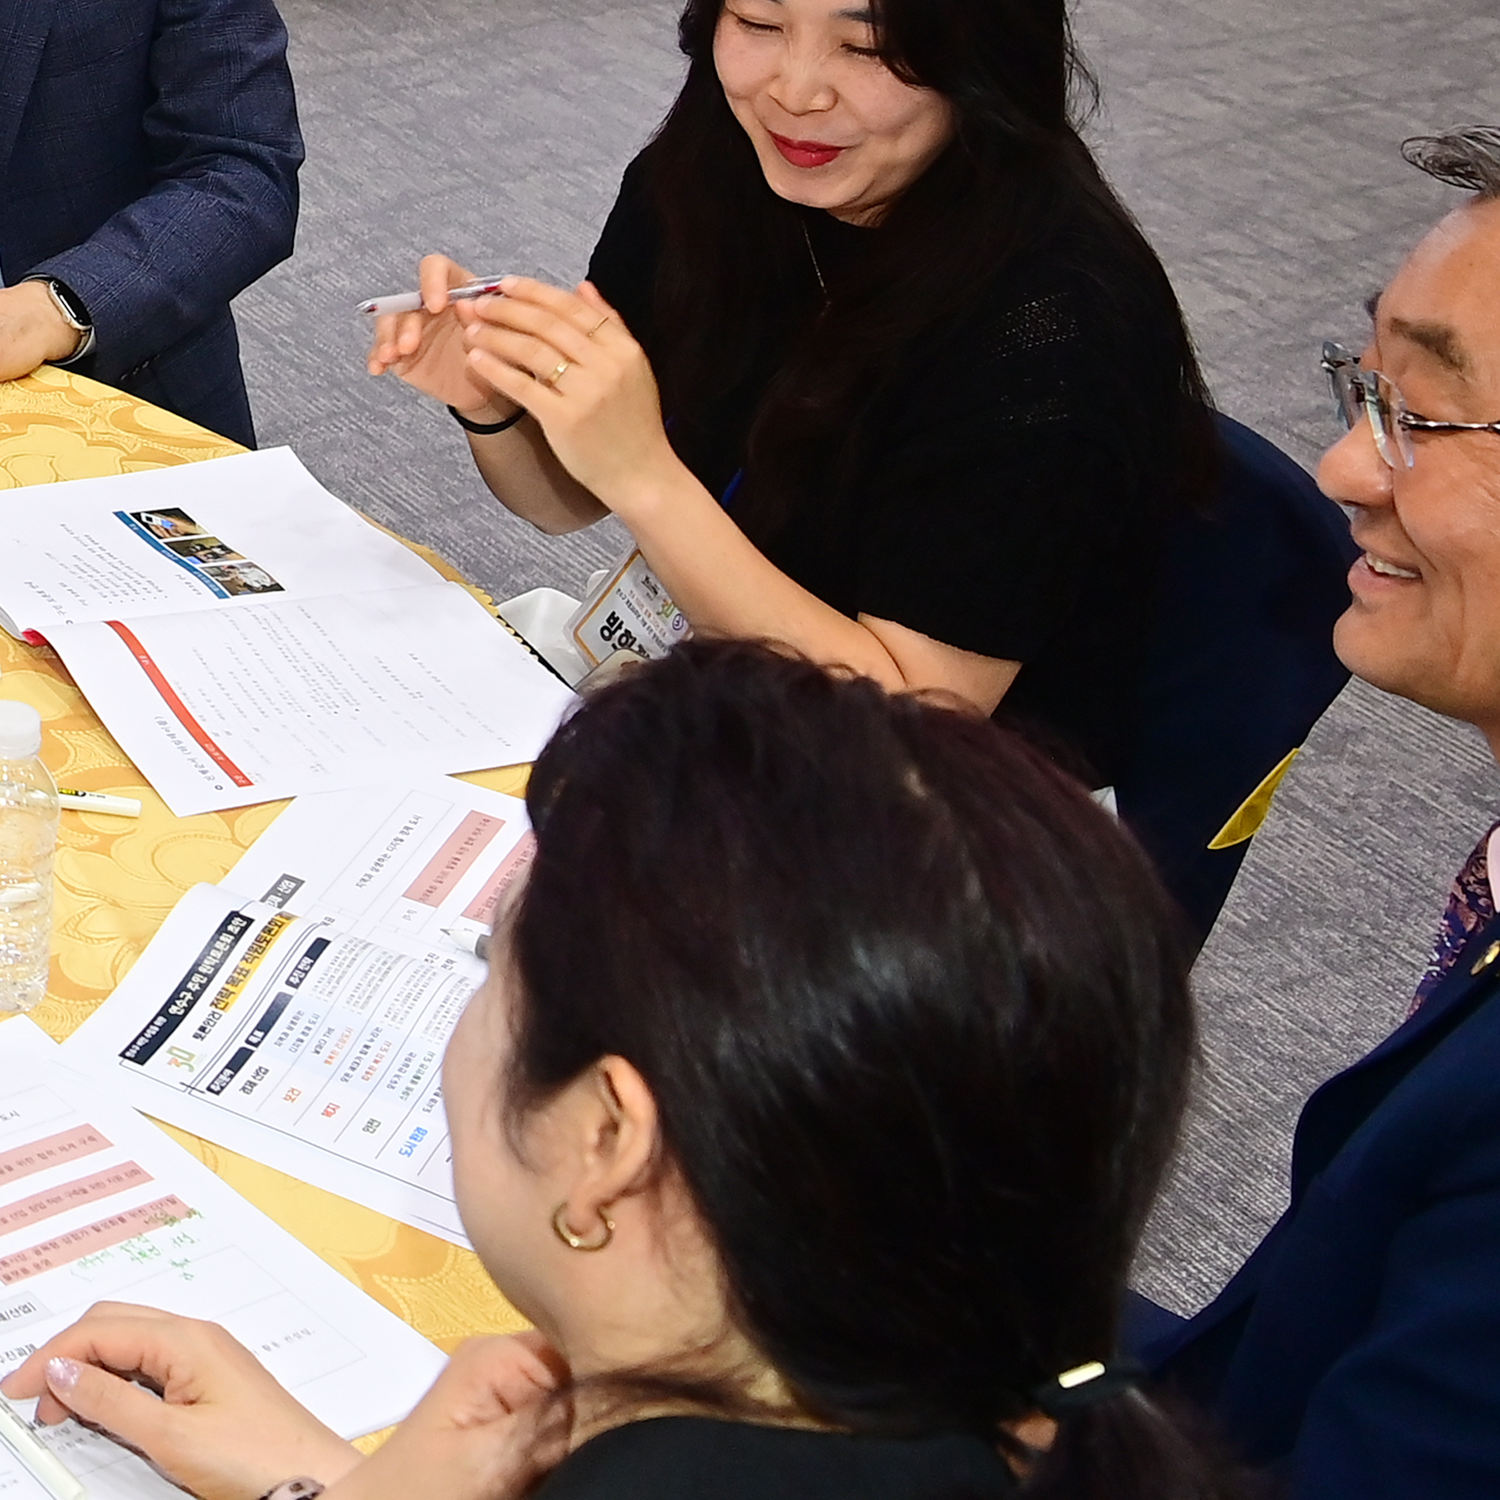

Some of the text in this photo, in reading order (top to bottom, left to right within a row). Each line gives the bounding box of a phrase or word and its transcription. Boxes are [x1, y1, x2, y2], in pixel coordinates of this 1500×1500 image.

[167, 988, 195, 1018] 연수구
[209, 986, 236, 1011] 전략
[282, 1086, 302, 1104] 보건
[361, 1117, 382, 1135] 안전
